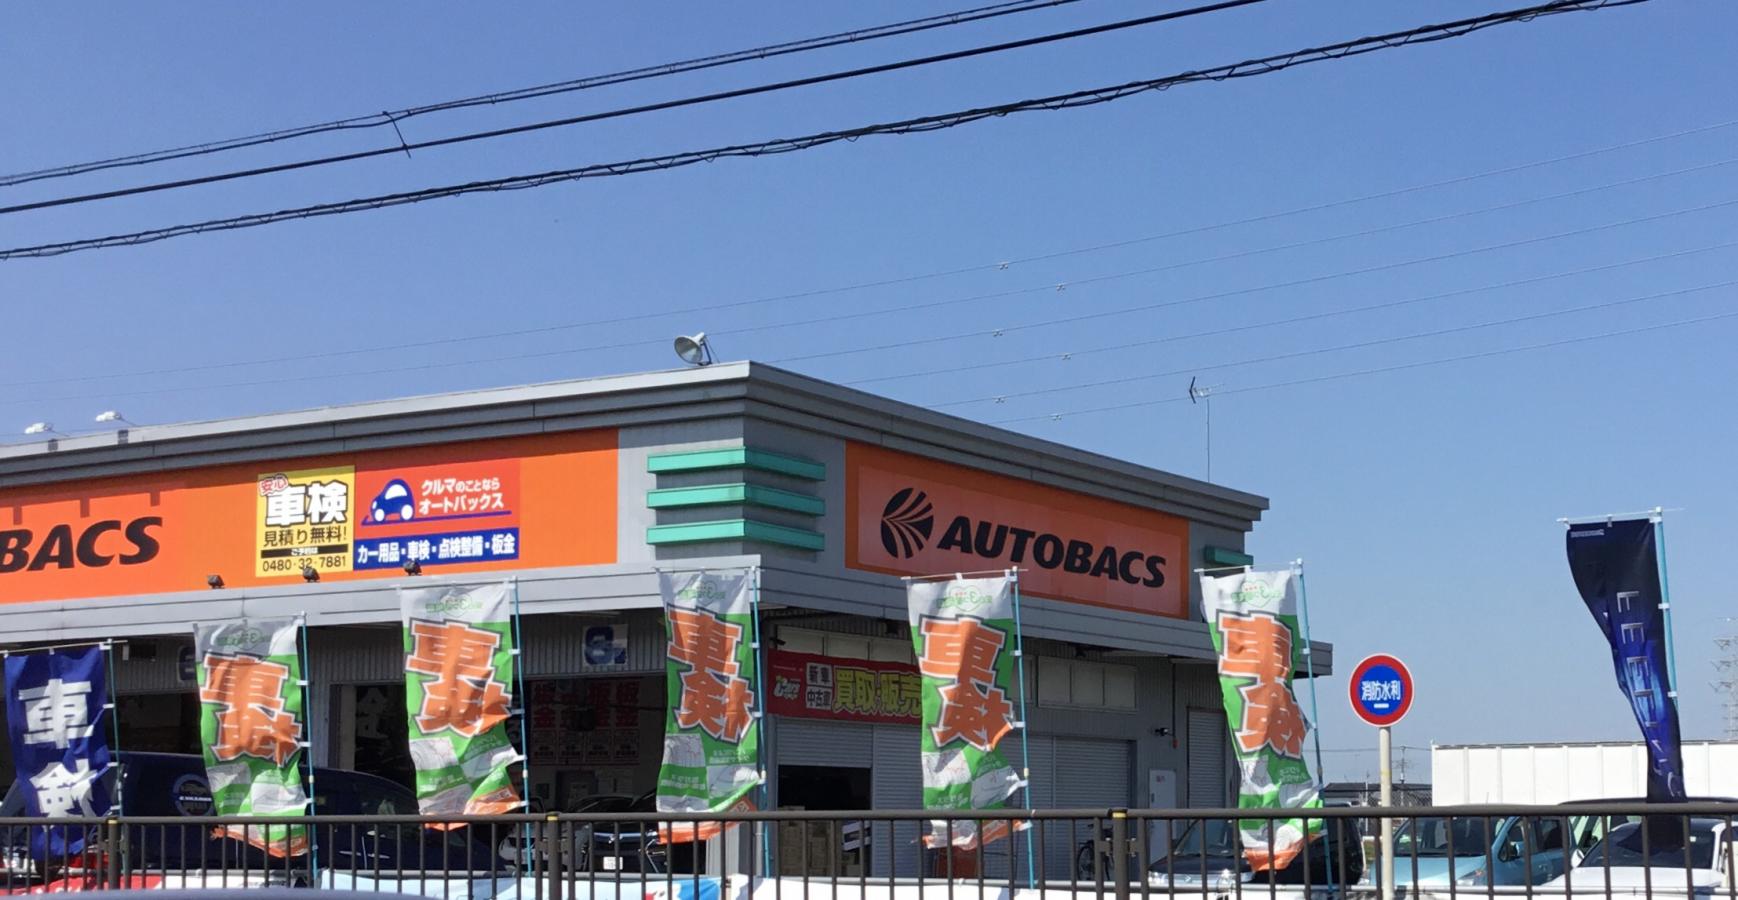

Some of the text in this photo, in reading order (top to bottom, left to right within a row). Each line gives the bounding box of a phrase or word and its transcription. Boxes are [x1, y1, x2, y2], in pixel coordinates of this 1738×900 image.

[421, 477, 500, 496] クルマのことなら
[266, 480, 348, 527] 車検
[419, 493, 504, 514] オートバックス
[0, 516, 163, 573] BACS
[263, 526, 347, 547] 見積り無料!
[936, 515, 1167, 588] AUTOBACS
[1361, 680, 1401, 700] 消防水利
